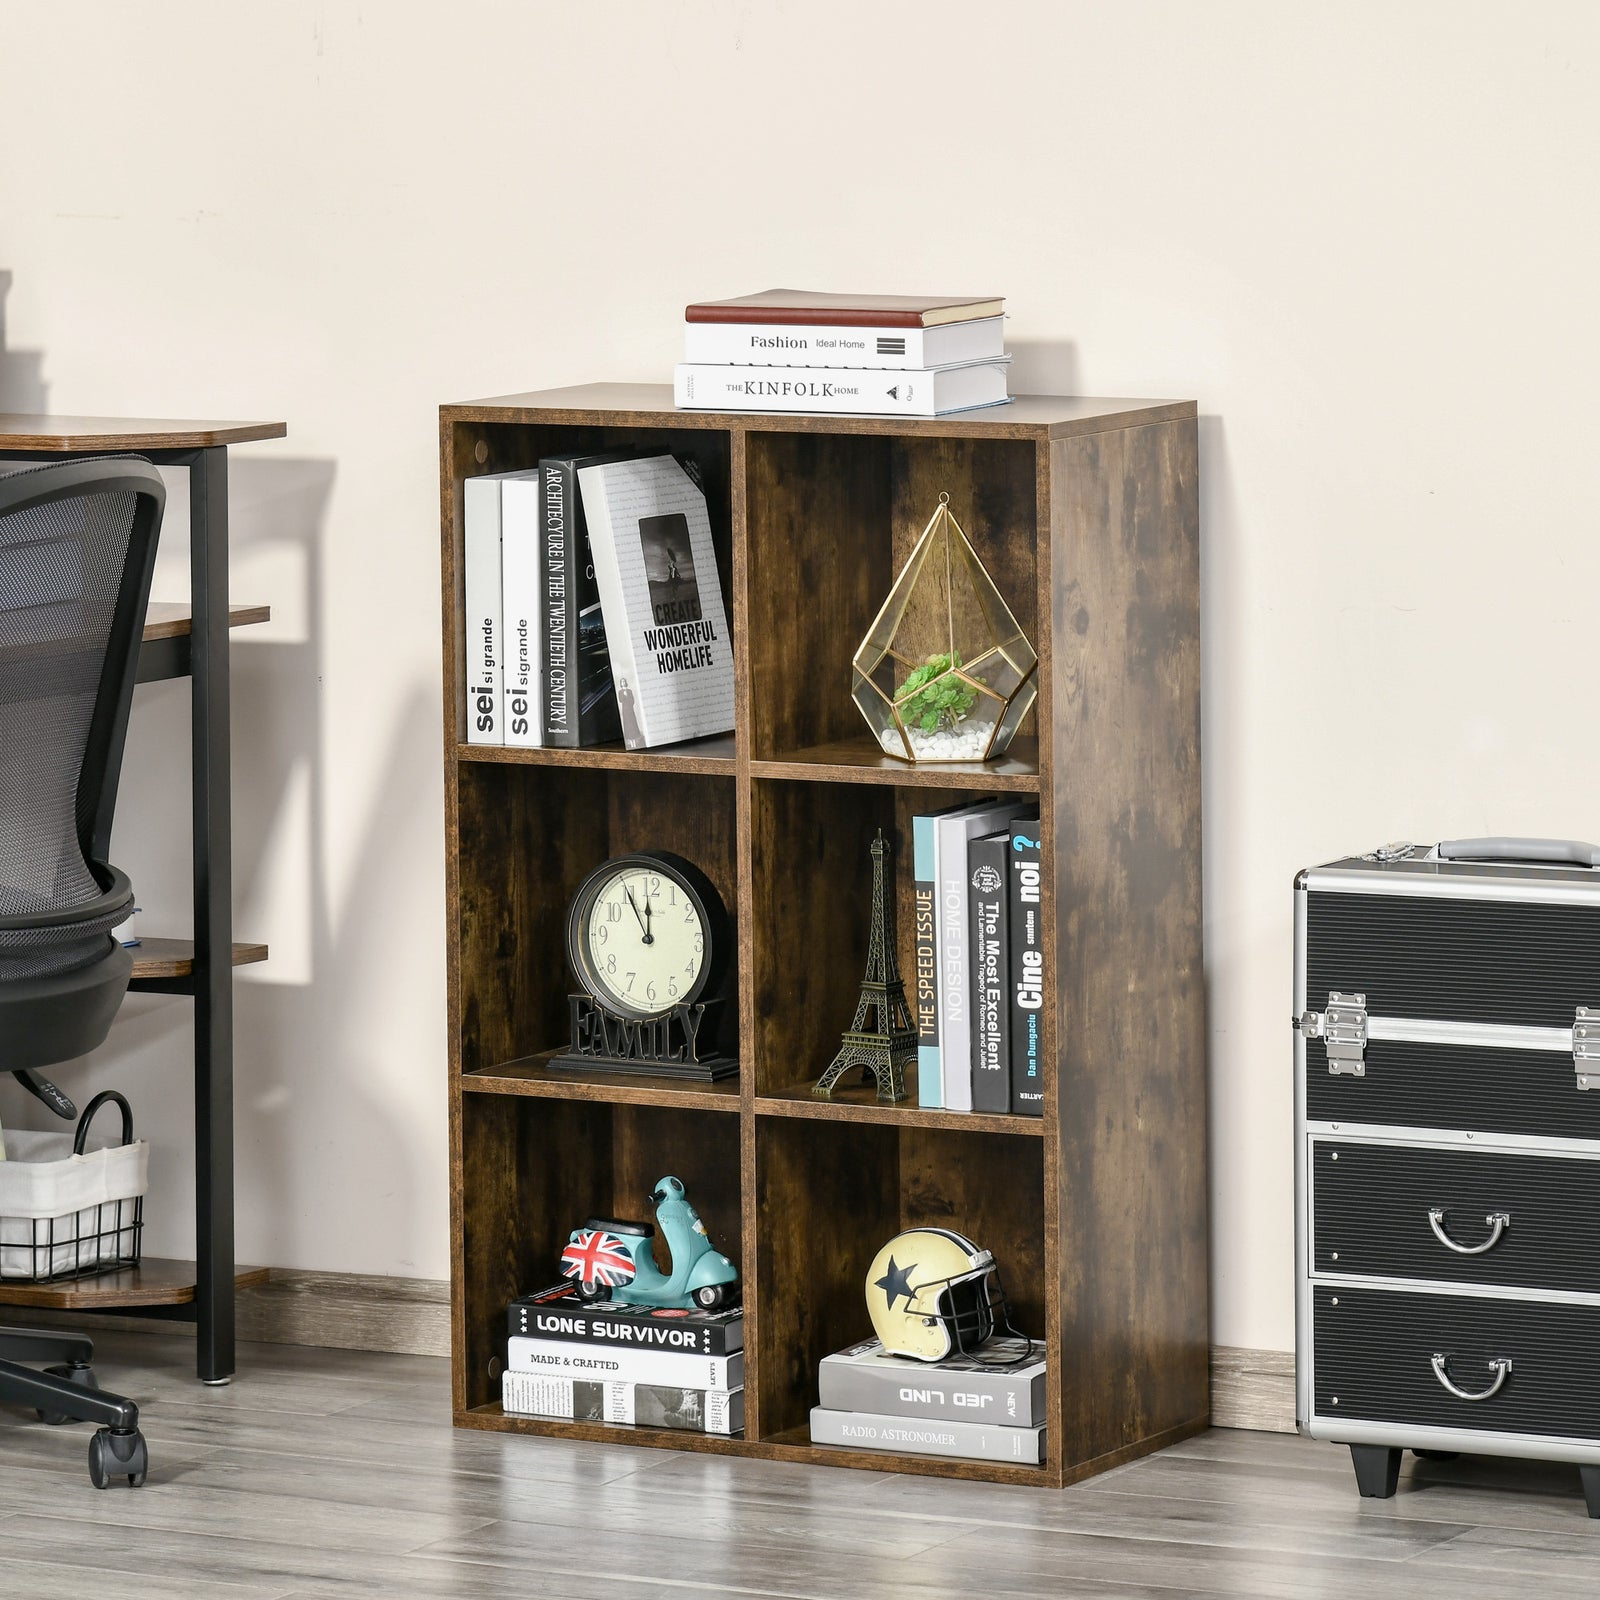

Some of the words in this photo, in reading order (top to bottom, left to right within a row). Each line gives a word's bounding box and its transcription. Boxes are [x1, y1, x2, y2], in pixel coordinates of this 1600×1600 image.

[750, 336, 808, 349] Fashion
[816, 338, 836, 348] Ideal
[839, 340, 865, 349] Home
[744, 381, 834, 397] KINFOLK
[546, 467, 564, 557] ARCHITECYURE
[549, 560, 564, 572] IN
[549, 575, 565, 597] THE
[655, 600, 698, 624] CREATE
[482, 618, 495, 667] grande
[550, 600, 566, 667] TWENTIETH
[644, 620, 717, 651] WONDERFUL
[657, 645, 713, 674] HOMELIFE
[550, 670, 566, 724] CENTURY
[471, 686, 494, 732] sei
[506, 689, 528, 735] sei
[642, 877, 660, 898] 12
[1015, 861, 1040, 902] noi
[620, 884, 638, 905] 11
[668, 886, 676, 906] 1
[606, 902, 621, 922] 10
[684, 903, 695, 923] 2
[917, 890, 932, 942] ISSUE
[945, 880, 960, 939] HOME
[986, 902, 999, 935] The
[599, 926, 608, 945] 9
[694, 932, 703, 952] 3
[607, 954, 616, 974] 8
[685, 958, 694, 978] 4
[918, 946, 934, 1000] SPEED
[986, 940, 1000, 983] Most
[626, 972, 636, 992] 7
[646, 981, 656, 1000] 6
[668, 976, 678, 996] 5
[1017, 951, 1042, 1009] Cine
[980, 994, 986, 1003] of
[568, 994, 705, 1063] FAMILY
[920, 1004, 934, 1037] THE
[987, 988, 1001, 1070] Excellent
[1027, 1014, 1038, 1056] Dungaciu
[1027, 1059, 1036, 1077] Dan
[536, 1314, 586, 1334] LONE
[592, 1321, 697, 1348] SURVIVOR
[530, 1354, 562, 1366] MADE
[564, 1357, 572, 1366] &
[573, 1357, 619, 1370] CRAFTED
[899, 1388, 945, 1404] LIND
[953, 1391, 994, 1408] JED
[1007, 1392, 1016, 1418] NEW
[842, 1424, 877, 1438] RADIO
[881, 1429, 956, 1446] ASTRONOMER
